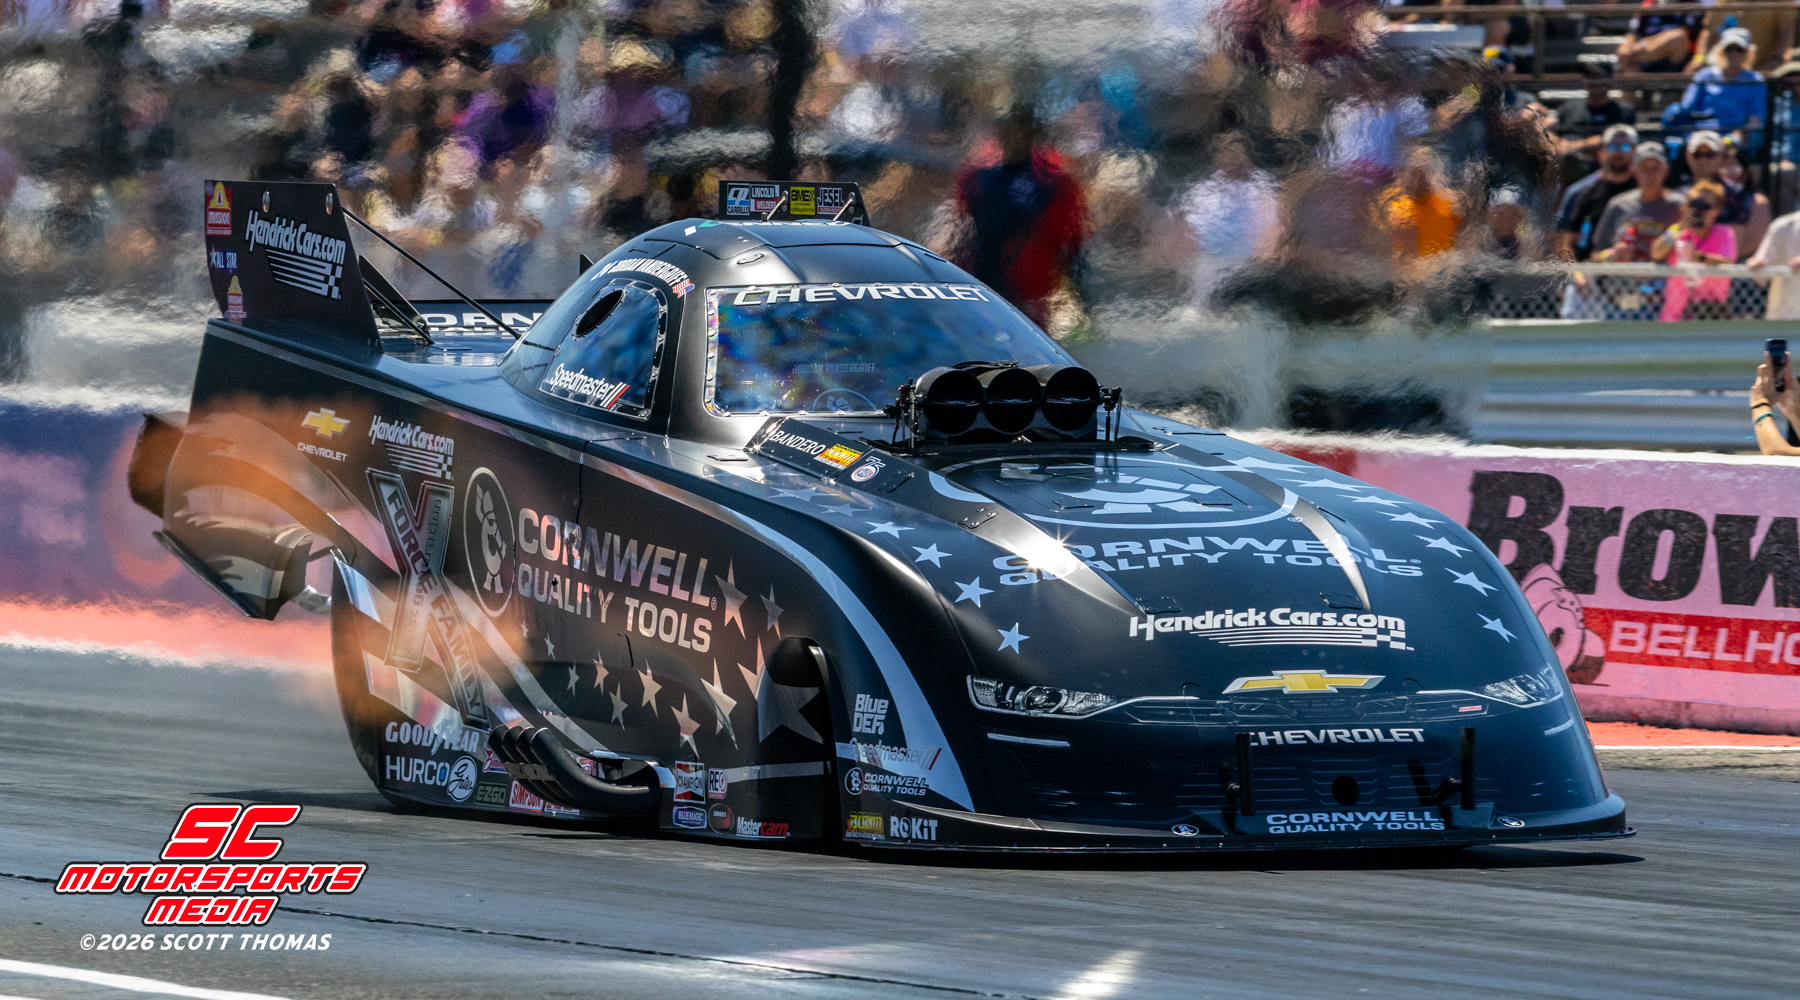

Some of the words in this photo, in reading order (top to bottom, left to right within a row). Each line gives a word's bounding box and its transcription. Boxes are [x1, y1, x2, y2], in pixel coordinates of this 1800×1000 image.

[752, 187, 775, 198] LINCOLN
[791, 190, 809, 201] BME
[818, 189, 844, 206] JESEL
[727, 206, 749, 215] CARRILLO
[756, 201, 777, 210] WELDERS
[226, 251, 238, 269] STAR
[733, 284, 990, 307] CHEVROLET
[792, 362, 824, 375] JORDAN
[825, 362, 877, 374] VANDERGRIFF
[549, 363, 614, 403] Speedmaster
[297, 441, 348, 462] CHEVROLET
[770, 430, 827, 456] BANDERO
[999, 551, 1230, 586] QUALITY
[1252, 551, 1424, 577] TOOLS
[387, 489, 438, 595] FORCE
[430, 593, 482, 710] FAMILY
[517, 562, 615, 625] QUALITY
[624, 596, 713, 654] TOOLS
[854, 693, 889, 714] Blue
[852, 712, 886, 735] DEF
[849, 737, 926, 764] Speedmaster
[385, 755, 450, 787] HURCO
[511, 783, 541, 807] SIMPSON
[862, 783, 896, 793] QUALITY
[896, 786, 927, 796] TOOLS
[737, 816, 789, 836] Mastercam
[1268, 822, 1364, 834] QUALITY
[1373, 822, 1446, 831] TOOLS
